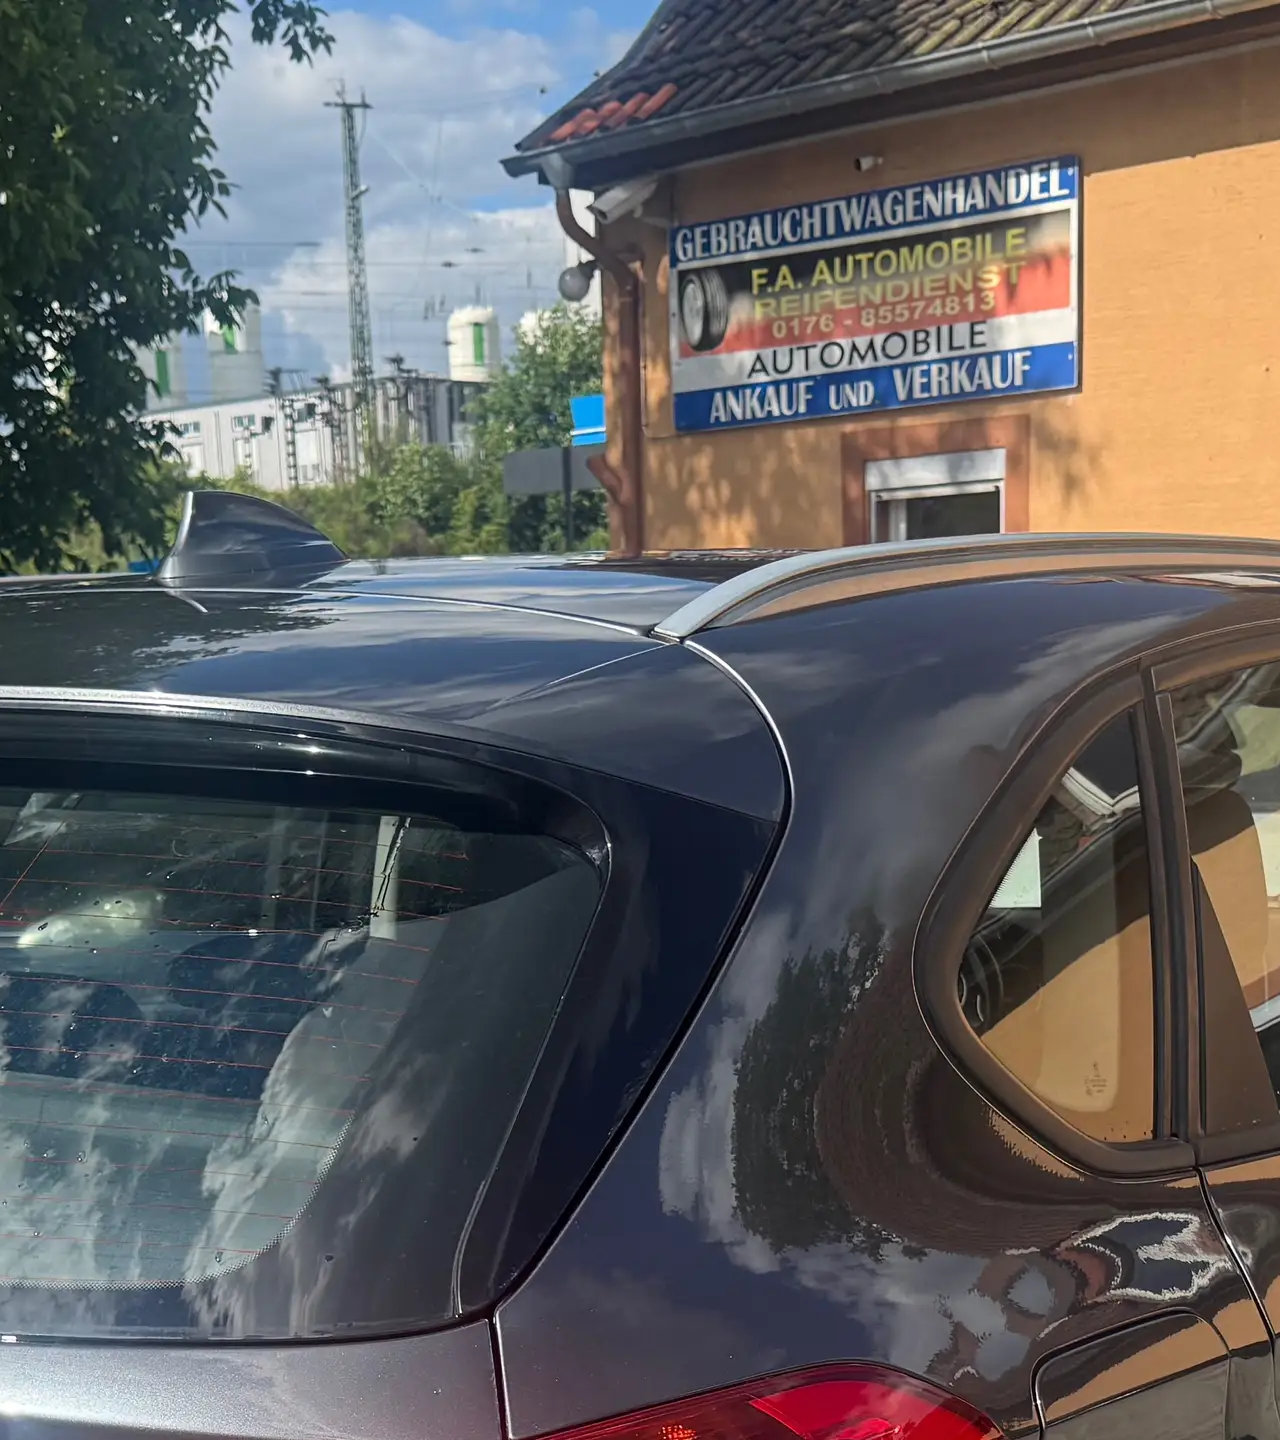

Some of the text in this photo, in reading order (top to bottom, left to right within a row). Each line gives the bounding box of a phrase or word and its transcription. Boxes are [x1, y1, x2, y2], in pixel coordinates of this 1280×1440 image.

[674, 160, 1070, 262] GEBRAUCHTWAGENHANDEL
[750, 228, 1028, 296] F.A. AUTOMOBILE
[753, 261, 1027, 320] REIFENDIENST
[772, 314, 835, 339] 0176
[860, 290, 996, 329] 85574813
[747, 320, 988, 379] AUTOMOBILE
[710, 351, 1032, 424] ANKAUF UND VERKAUF
